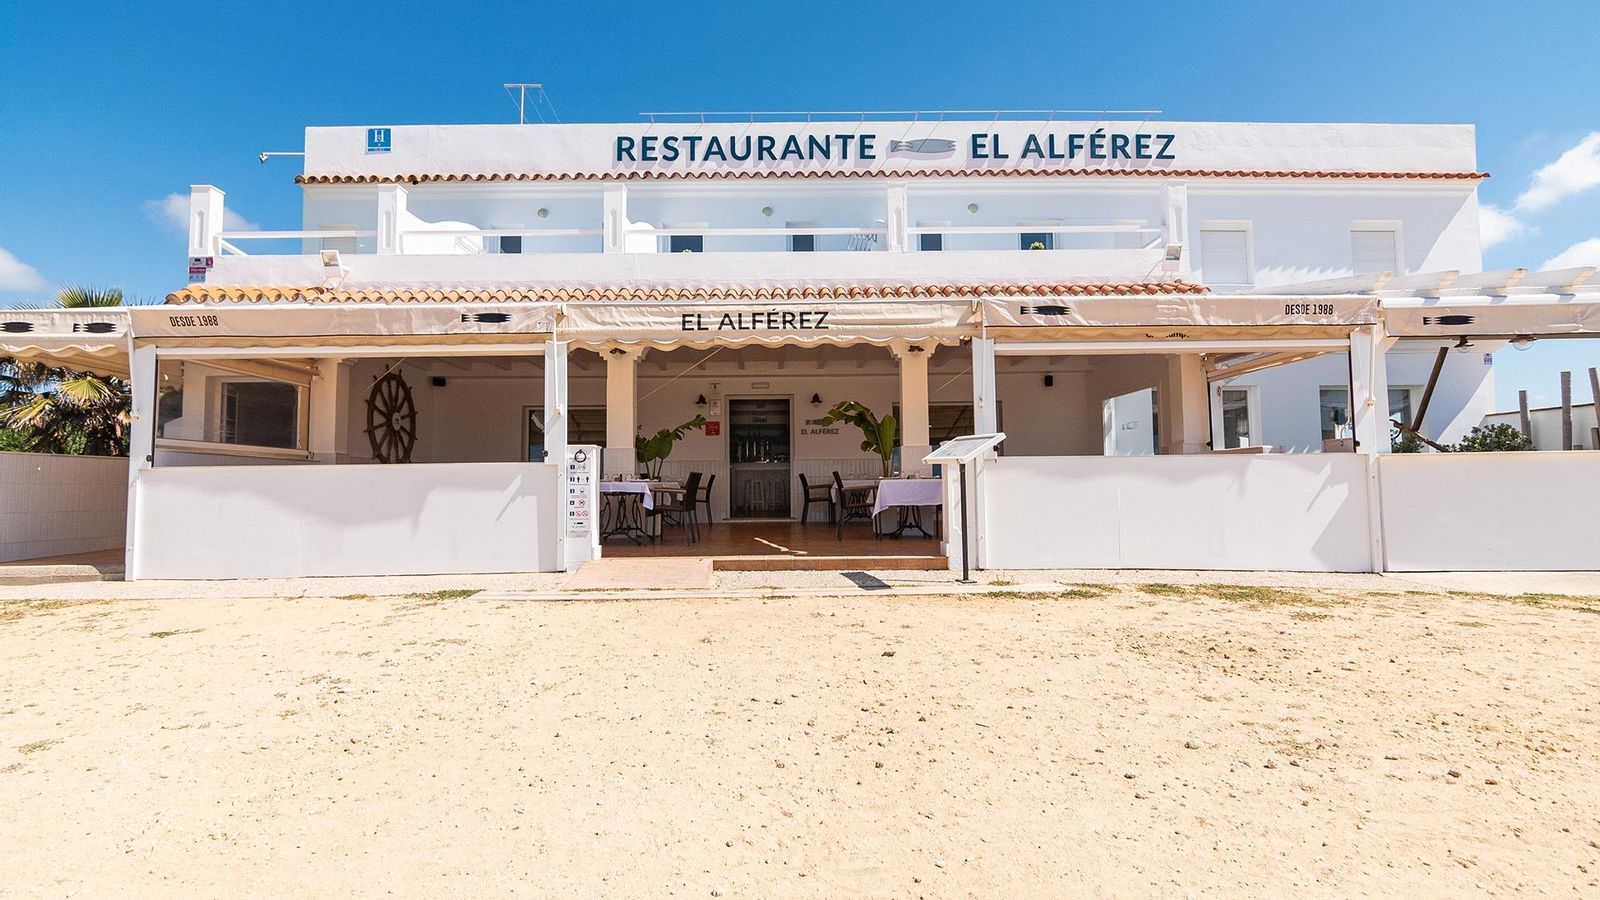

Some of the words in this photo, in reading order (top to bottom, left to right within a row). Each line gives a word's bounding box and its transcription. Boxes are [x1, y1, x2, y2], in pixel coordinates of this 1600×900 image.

[616, 134, 876, 162] RESTAURANTE
[971, 133, 1009, 159] EL
[1020, 127, 1176, 159] ALFÉREZ
[1285, 304, 1310, 315] DESDE
[1312, 304, 1334, 315] 1988
[169, 316, 196, 327] DESDE
[197, 315, 219, 326] 1988
[681, 313, 709, 331] EL
[717, 308, 829, 330] ALFÉREZ
